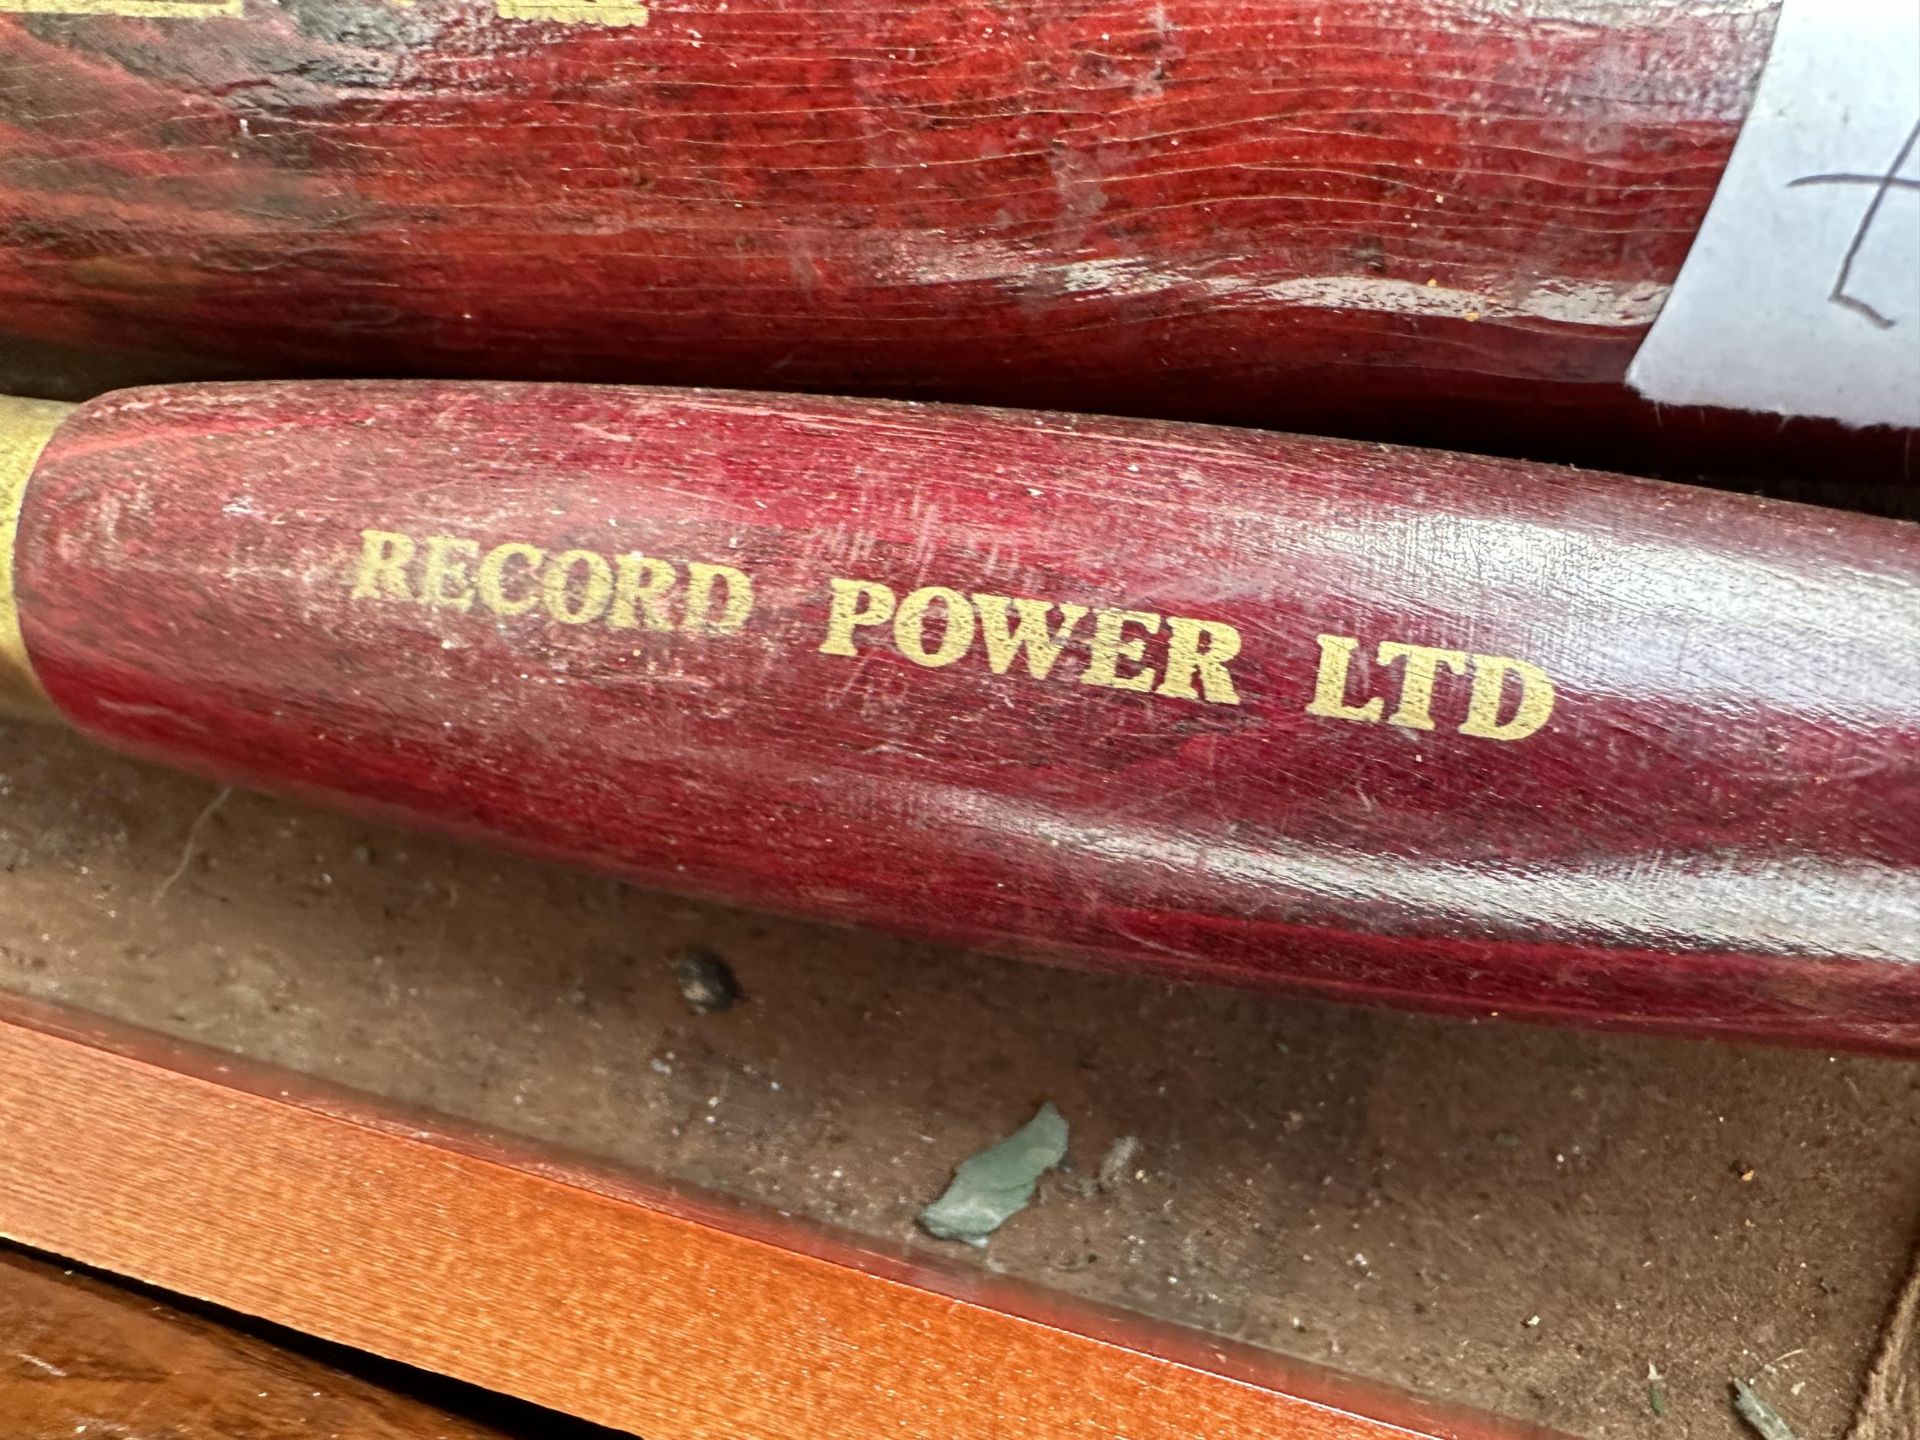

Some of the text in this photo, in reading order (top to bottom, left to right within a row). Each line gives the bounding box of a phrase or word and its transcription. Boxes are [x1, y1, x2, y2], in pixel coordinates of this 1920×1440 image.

[351, 528, 1556, 741] RECORD POWER LTD
